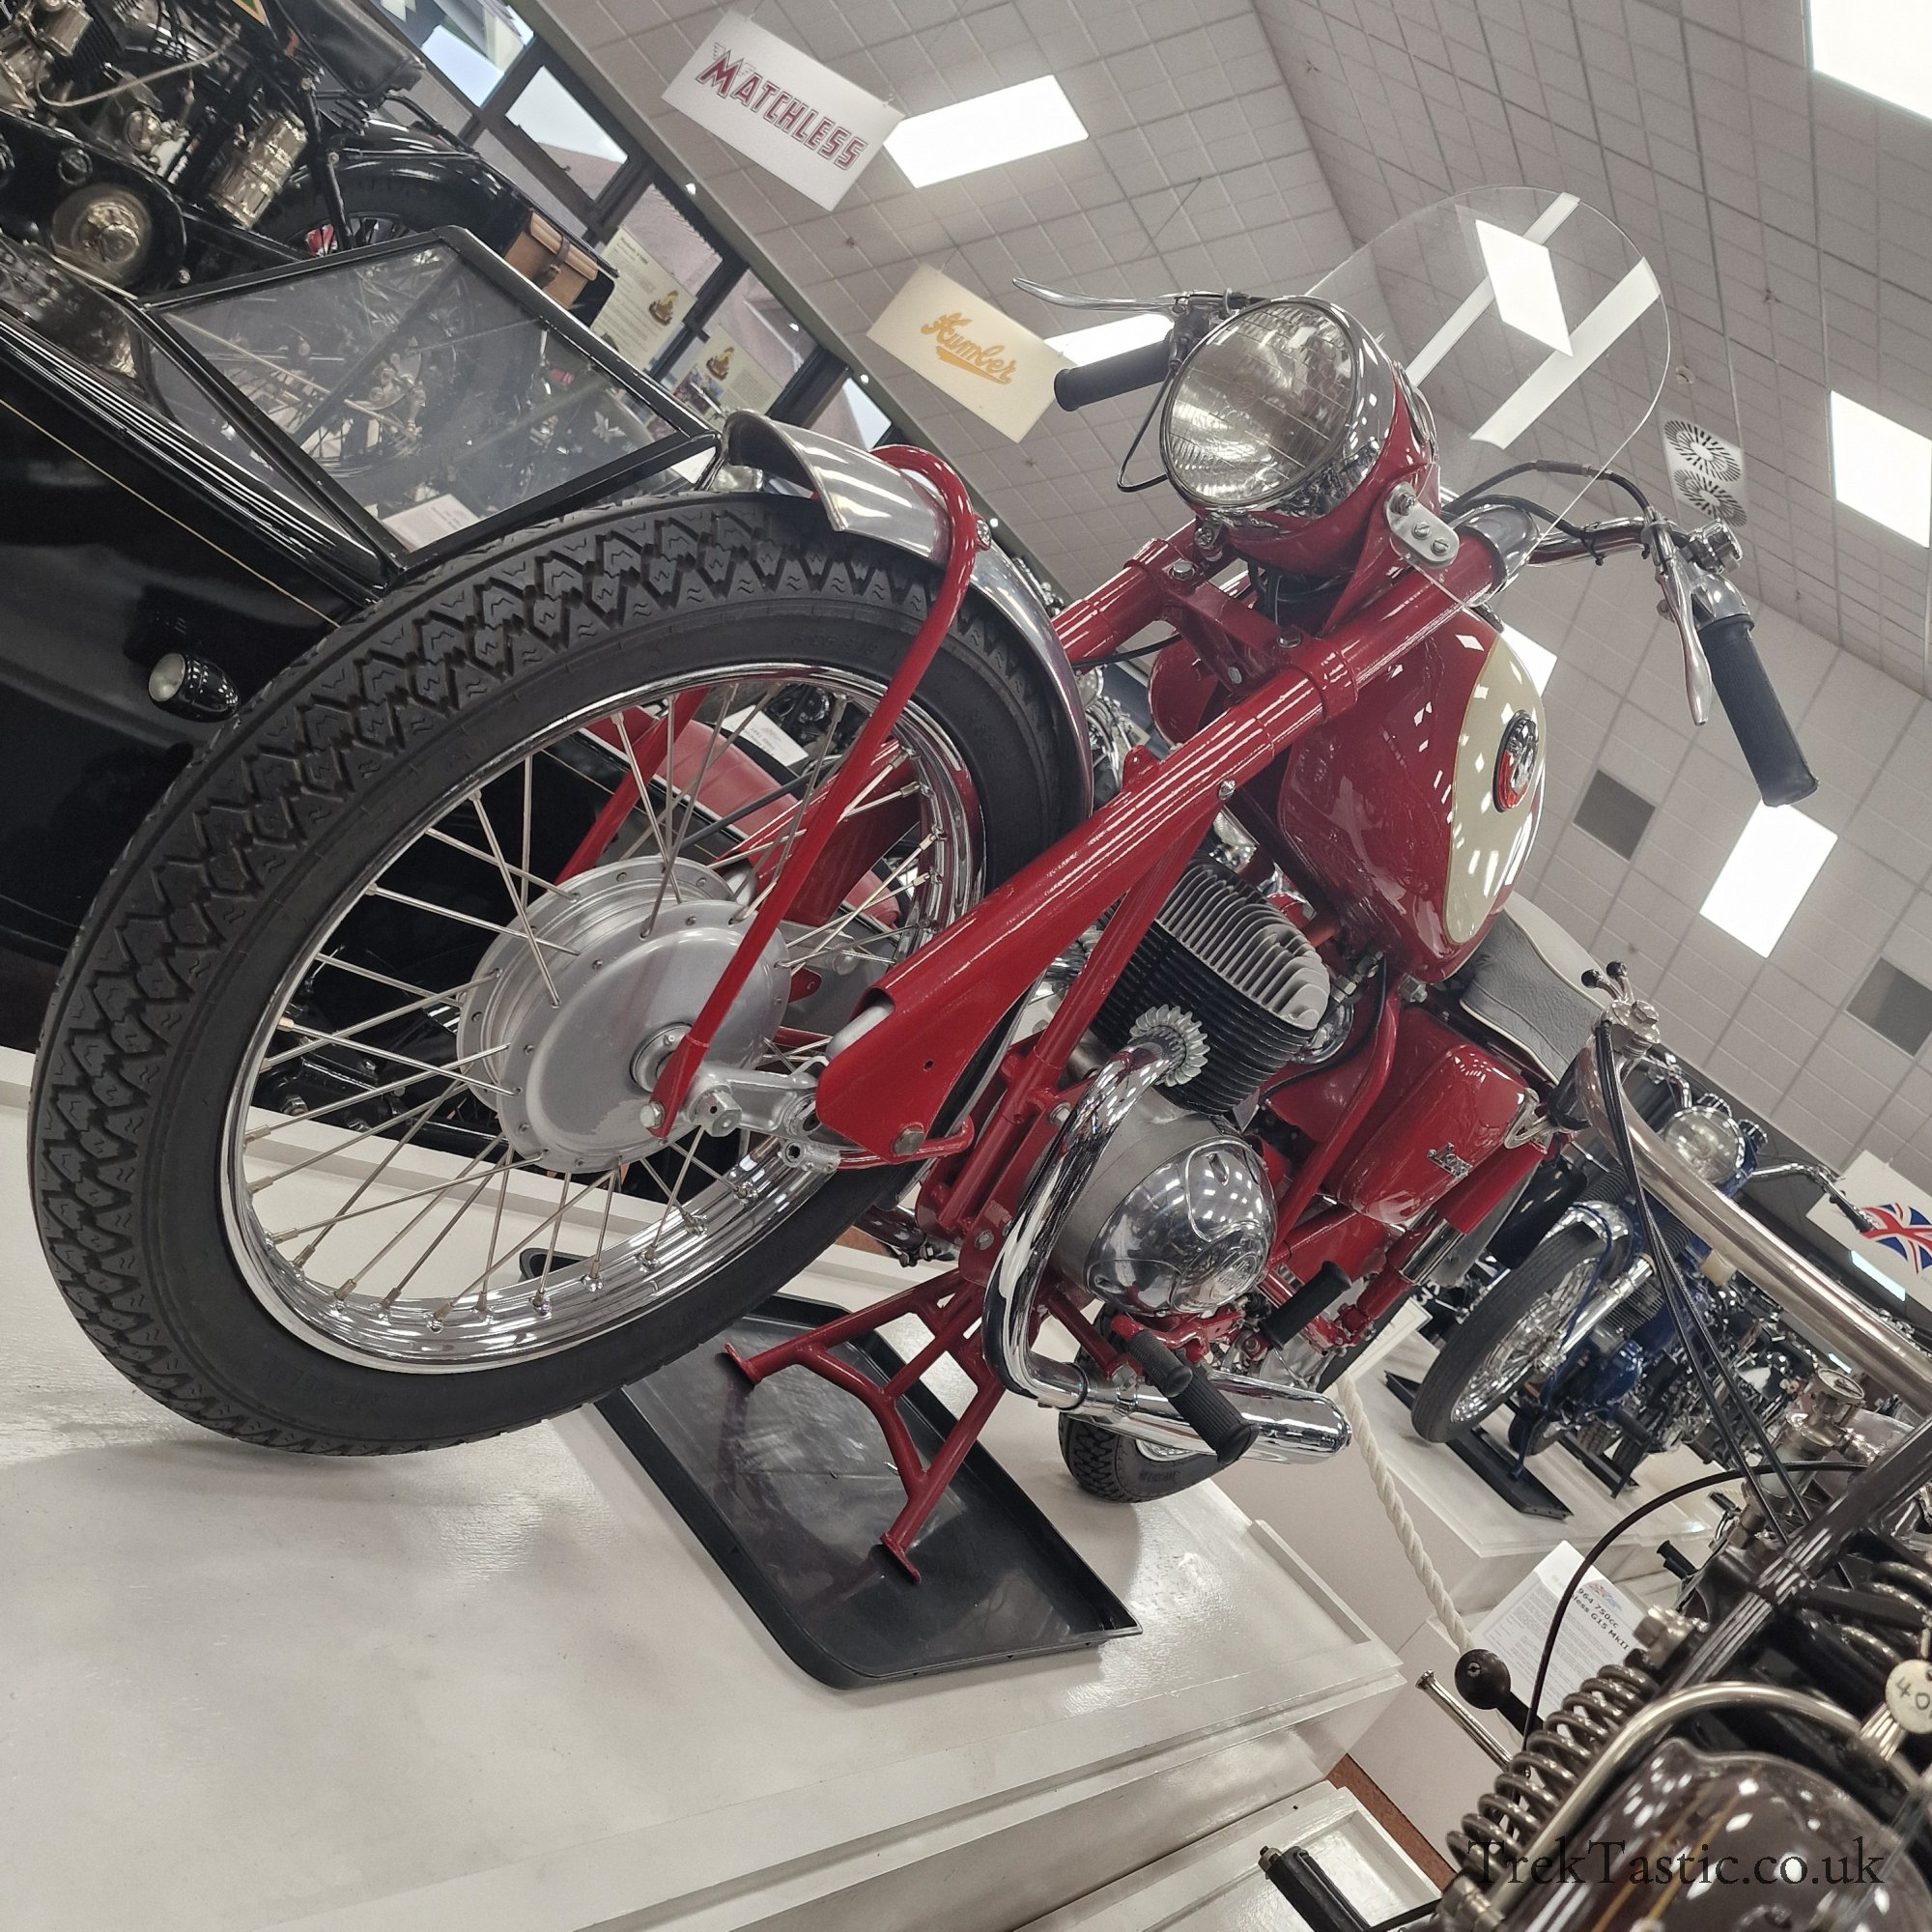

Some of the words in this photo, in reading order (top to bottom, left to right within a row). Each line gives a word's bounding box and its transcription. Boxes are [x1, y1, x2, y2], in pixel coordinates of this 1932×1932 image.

[695, 48, 869, 171] MATCHLESS
[921, 312, 1017, 384] Humber
[1577, 1587, 1594, 1604] 964
[1594, 1604, 1619, 1629] 750cc
[1590, 1612, 1608, 1630] G15
[1607, 1630, 1630, 1650] MkII
[1895, 1676, 1932, 1719] 40
